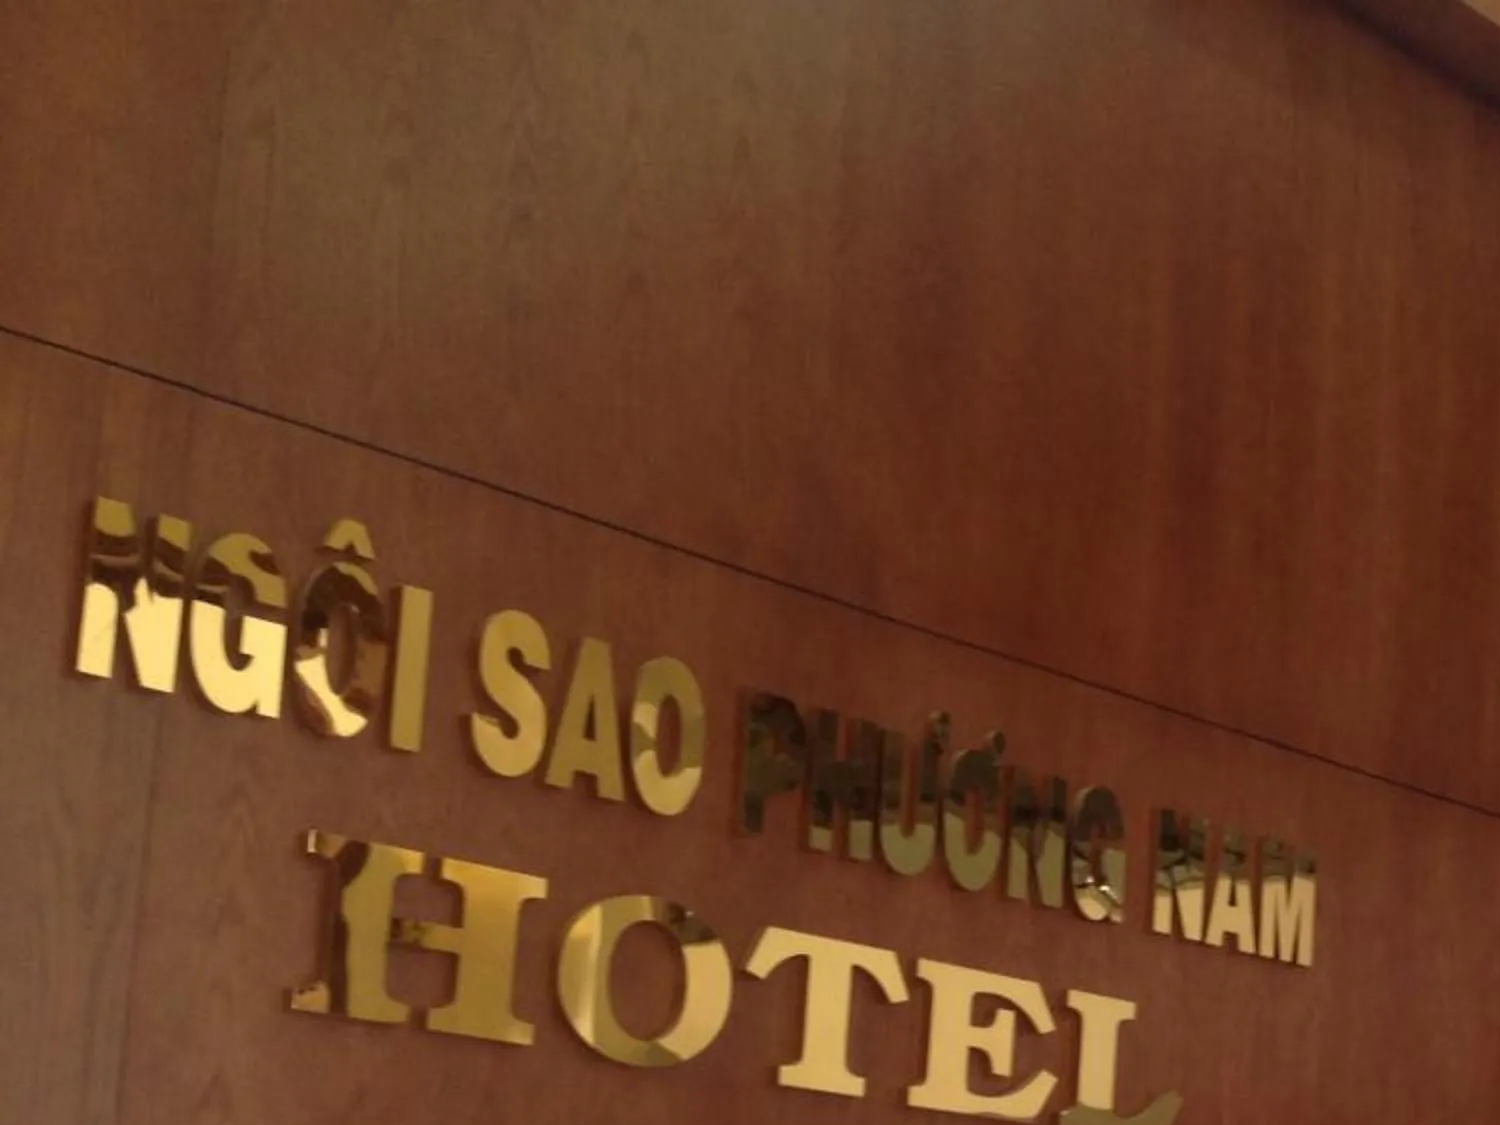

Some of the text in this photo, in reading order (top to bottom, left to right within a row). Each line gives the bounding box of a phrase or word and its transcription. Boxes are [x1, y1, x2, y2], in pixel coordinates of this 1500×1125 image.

[76, 496, 432, 753] NGÔI
[470, 608, 706, 816] SAO
[1152, 808, 1317, 967] NAM
